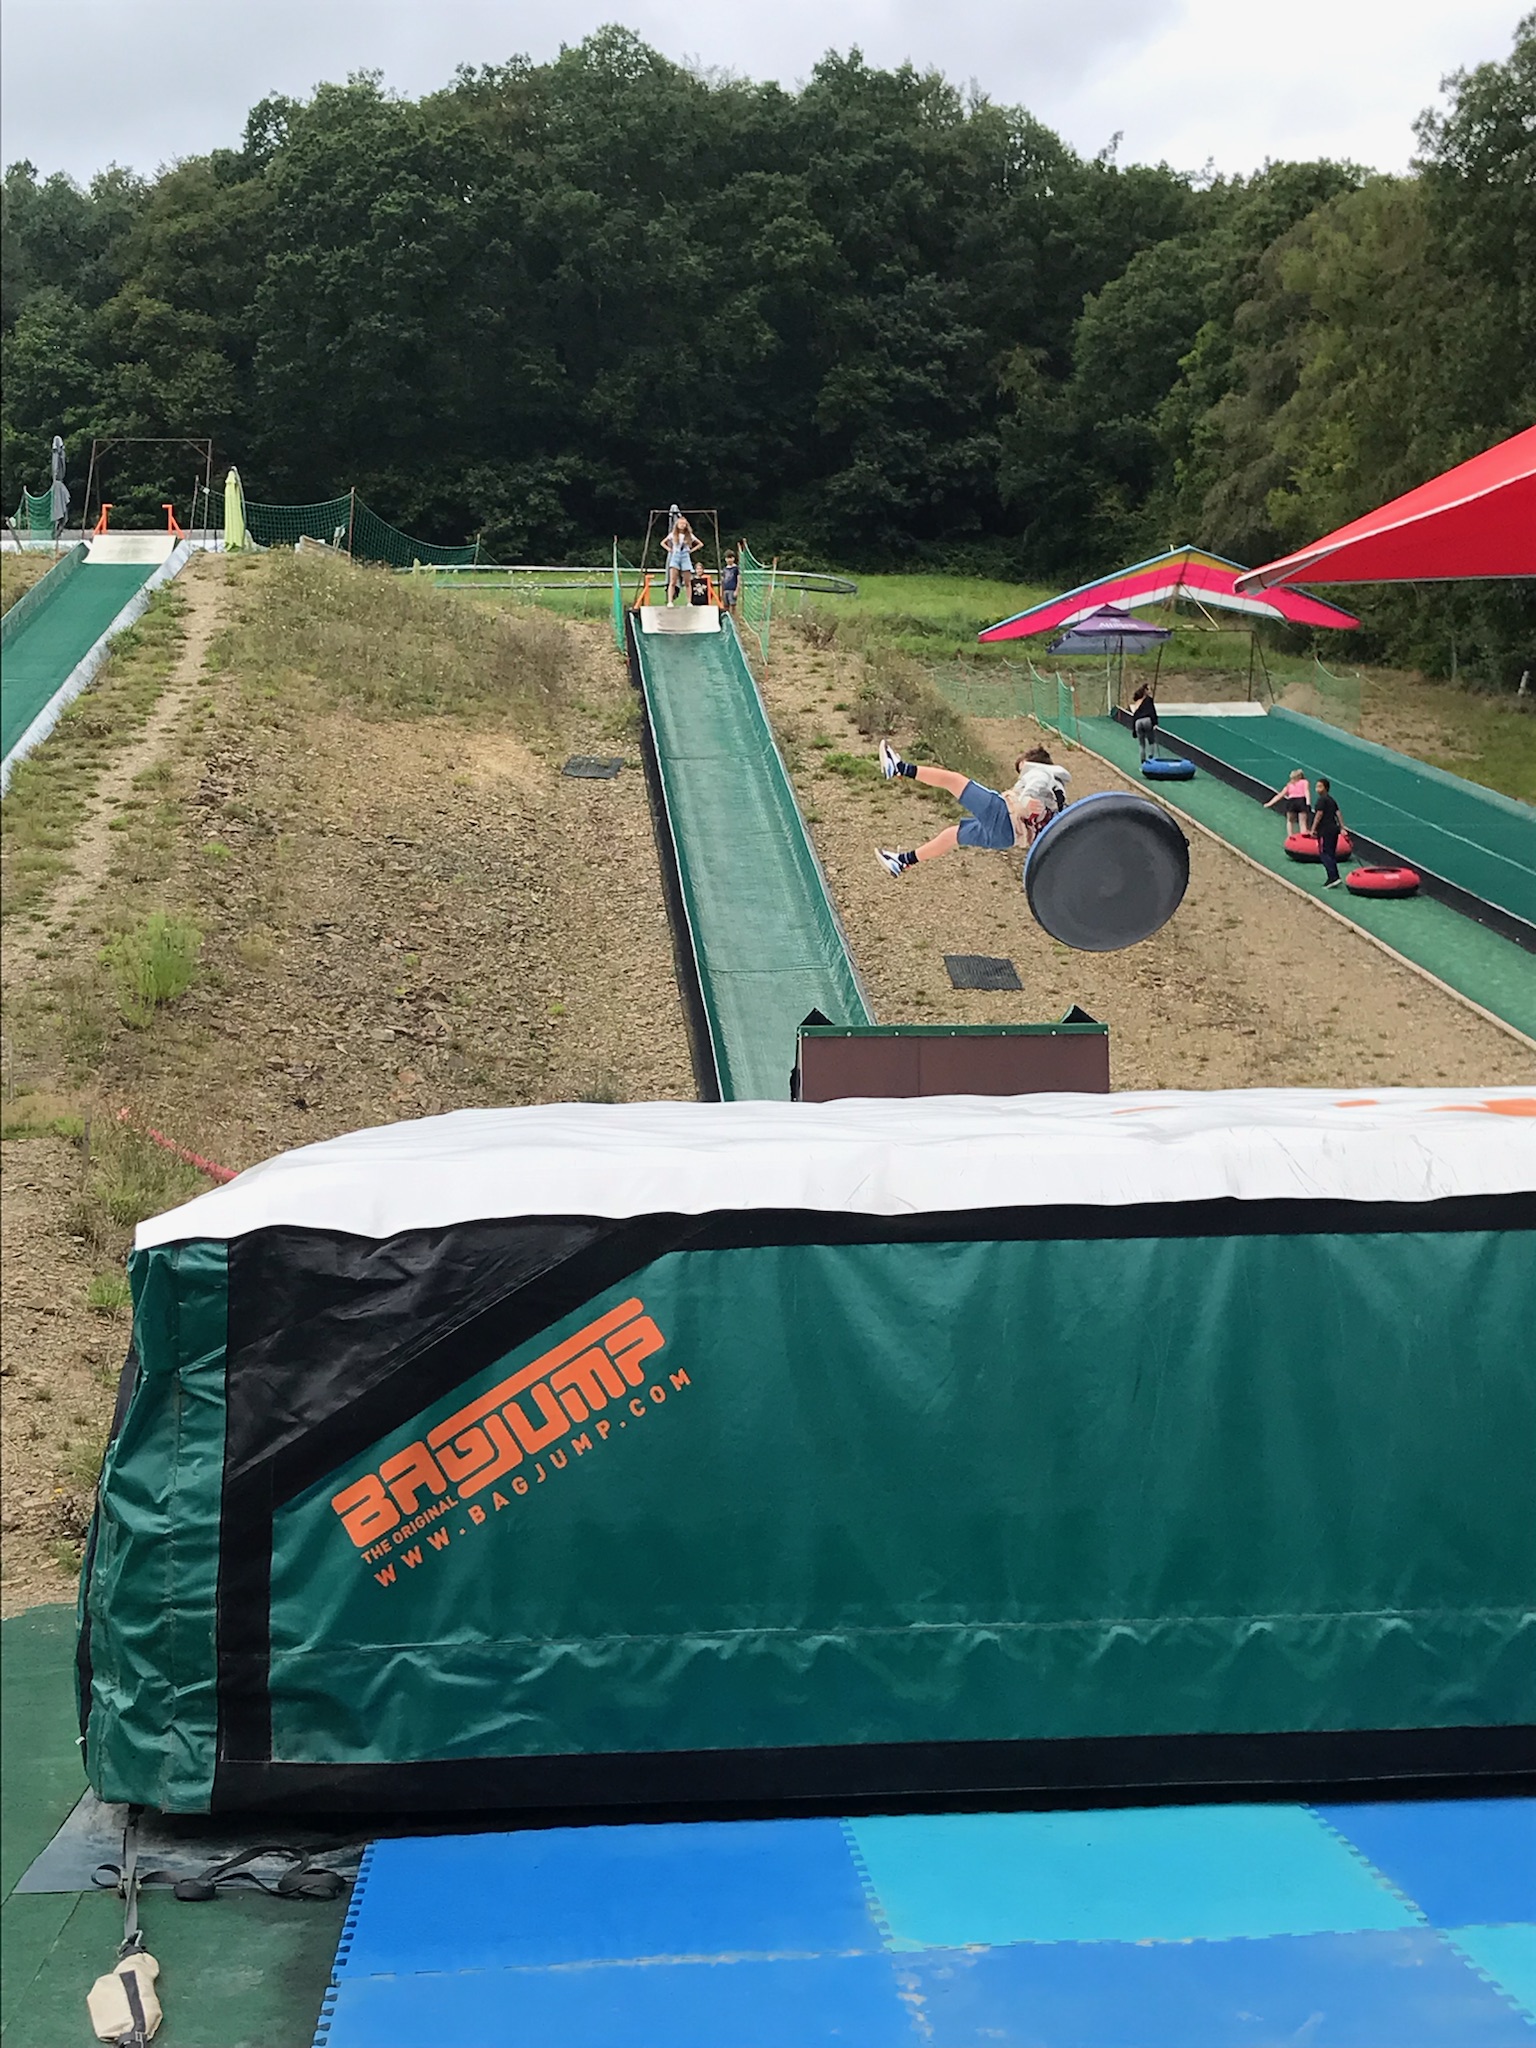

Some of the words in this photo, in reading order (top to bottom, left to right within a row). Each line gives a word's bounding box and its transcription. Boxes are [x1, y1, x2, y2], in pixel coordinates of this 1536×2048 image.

[331, 1297, 666, 1548] BAGJUMP
[361, 1539, 392, 1564] THE
[392, 1495, 459, 1544] ORIGINAL
[374, 1368, 691, 1587] WWW.BAGJUMP.COM
